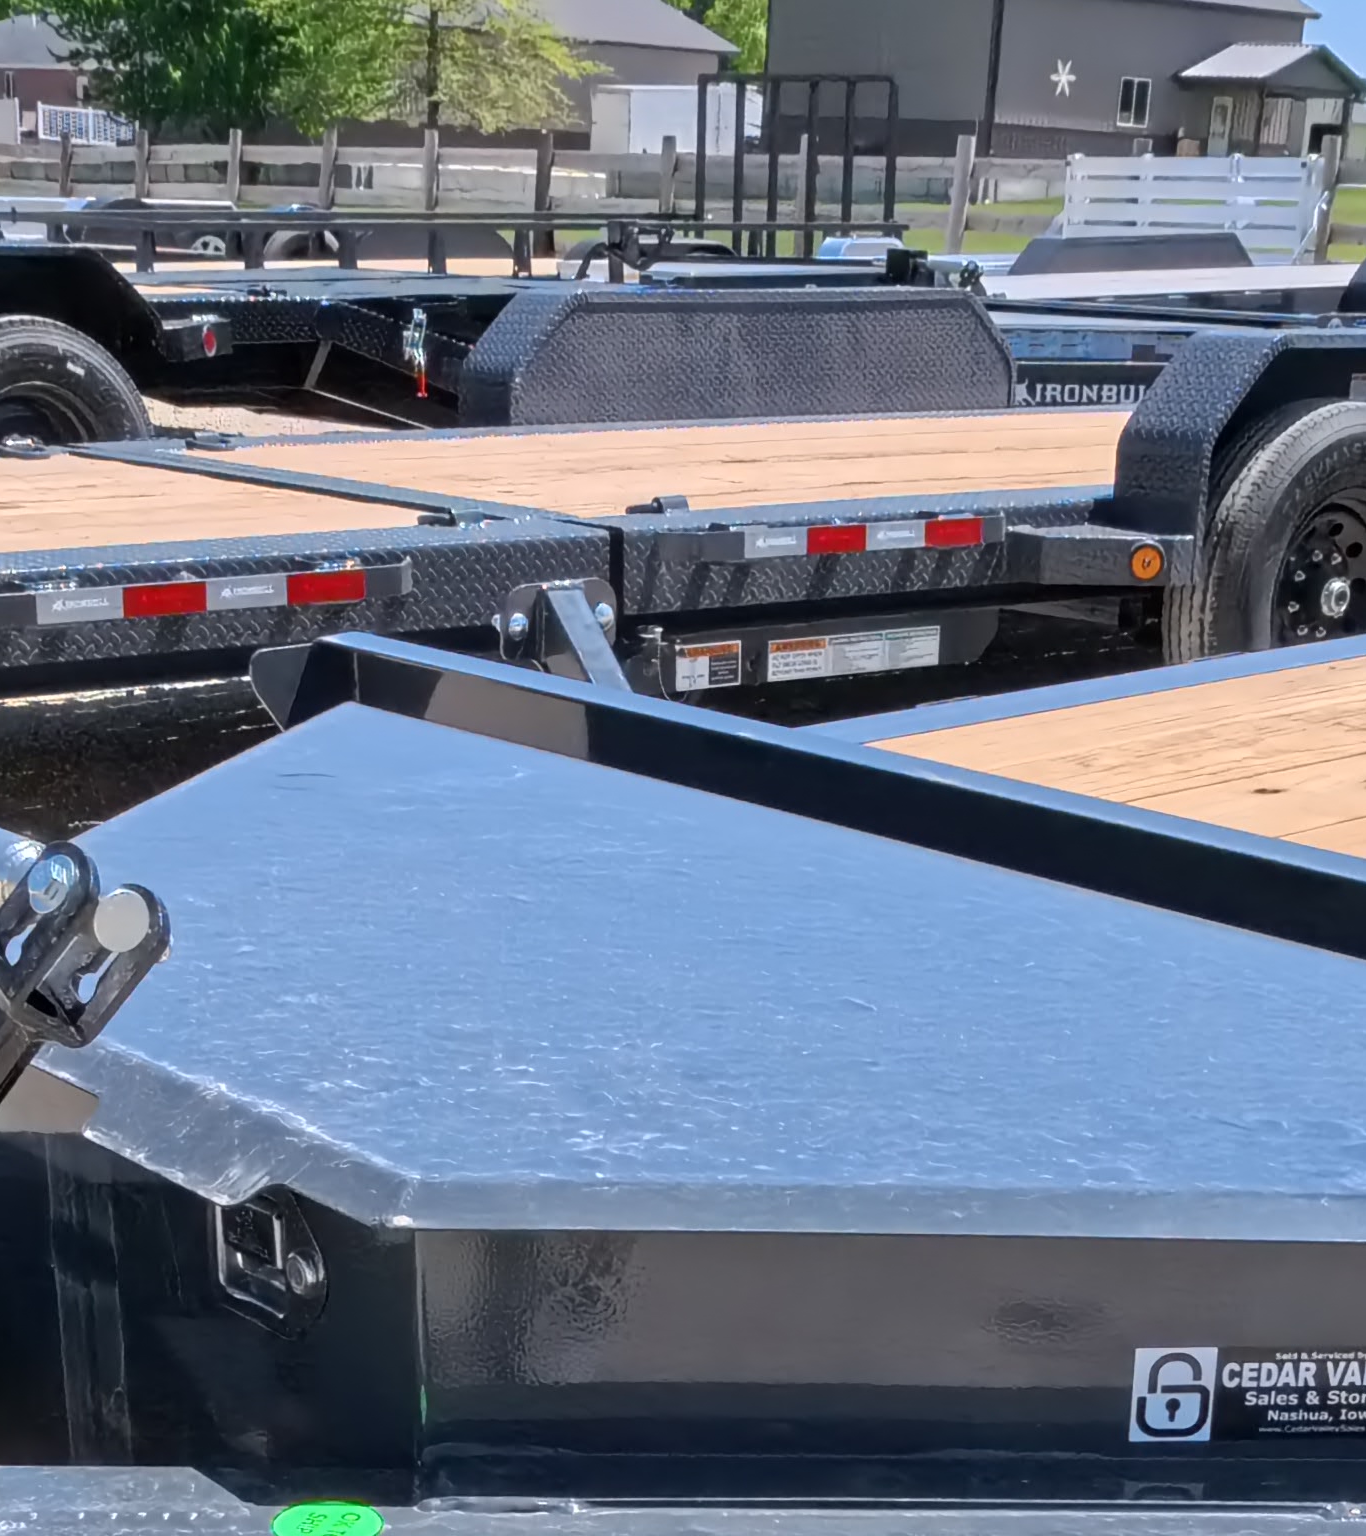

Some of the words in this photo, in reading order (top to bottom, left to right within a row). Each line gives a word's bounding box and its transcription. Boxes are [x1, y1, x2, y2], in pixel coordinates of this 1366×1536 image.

[1276, 1352, 1298, 1360] Sold
[1311, 1351, 1355, 1360] Serviced
[1221, 1361, 1317, 1388] CEDAR
[1244, 1390, 1299, 1406] Sales
[1305, 1390, 1320, 1405] &
[1267, 1409, 1333, 1422] Nashua,
